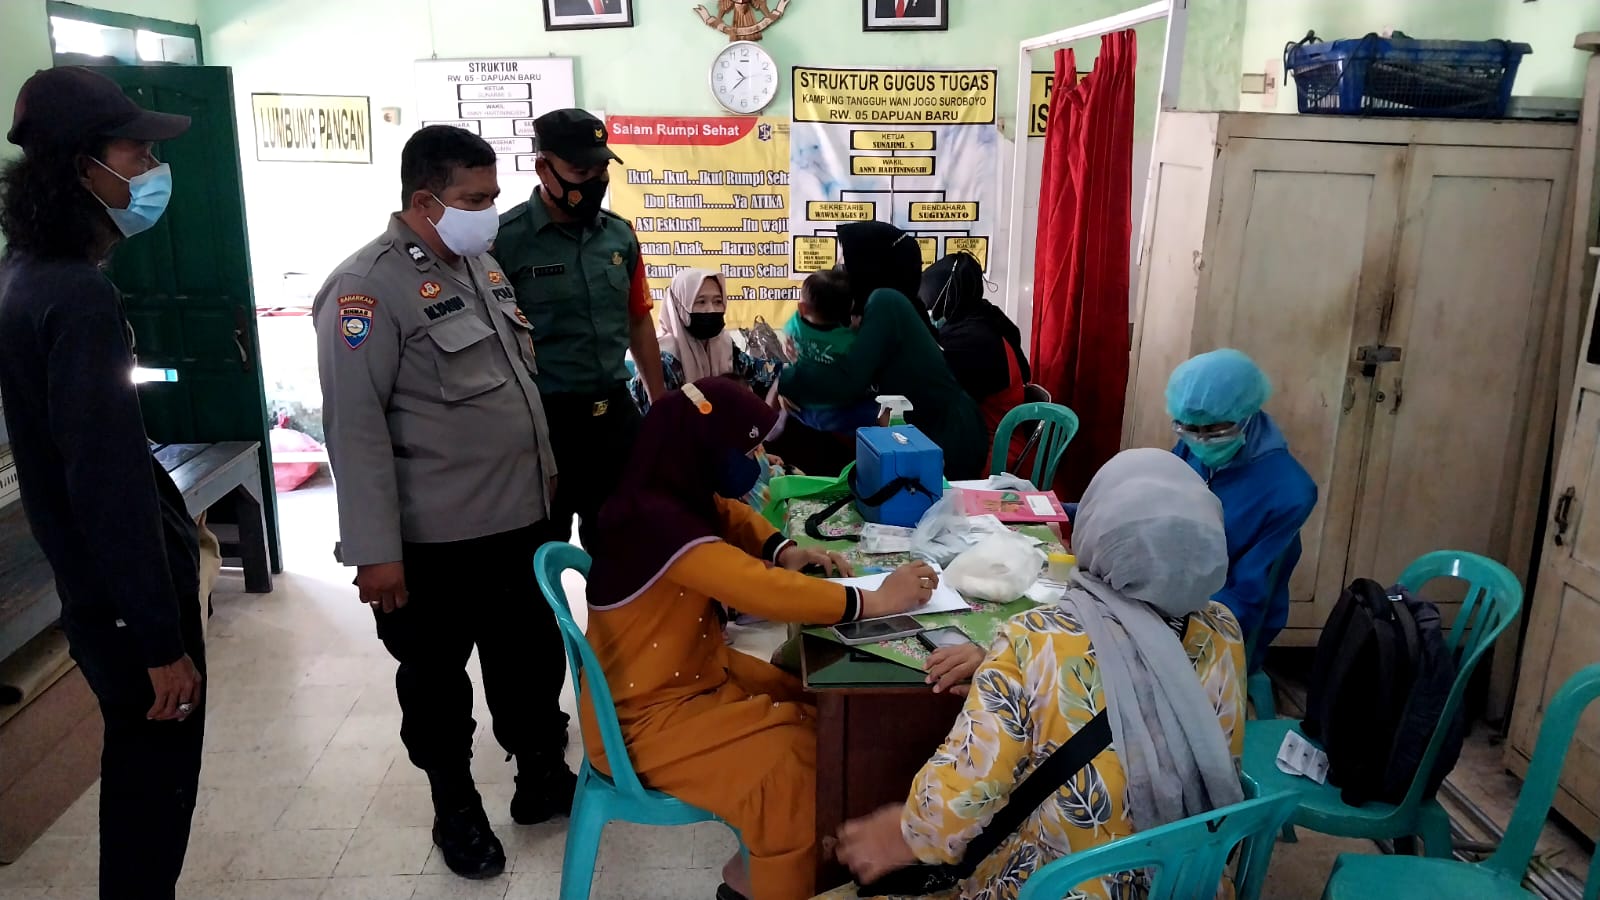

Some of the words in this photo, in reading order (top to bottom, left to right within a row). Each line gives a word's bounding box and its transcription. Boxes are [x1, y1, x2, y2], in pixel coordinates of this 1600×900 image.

[741, 48, 750, 57] 12
[468, 62, 519, 73] STRUKTUR
[481, 74, 516, 82] DAPUAN
[518, 73, 542, 81] BARU
[800, 71, 879, 91] STRUKTUR
[883, 74, 936, 92] GUGUS
[940, 74, 989, 92] TUGAS
[802, 93, 845, 106] KAMPUNG
[846, 96, 888, 107] TANGGUH
[889, 97, 912, 107] WANI
[913, 97, 938, 107] JOGO
[939, 96, 987, 107] SUROBOYO
[830, 109, 852, 121] RW.
[855, 110, 868, 121] 05
[871, 110, 922, 121] DAPUAN
[925, 110, 959, 121] BARU
[259, 106, 317, 150] LUMBUNG
[318, 107, 366, 151] PANGAN
[612, 123, 653, 135] Salam
[656, 124, 699, 138] Rumpi
[702, 124, 740, 136] Sehat
[725, 170, 765, 187] Rumpi
[643, 194, 665, 209] Ibu
[750, 194, 784, 209] ATIKA
[819, 203, 865, 211] SEKRETARIS
[921, 203, 967, 211] BENDAHARA
[918, 211, 970, 219] SUGIYANTO
[636, 217, 654, 232] ASI
[720, 264, 754, 278] Harus
[756, 264, 788, 278] Sehat
